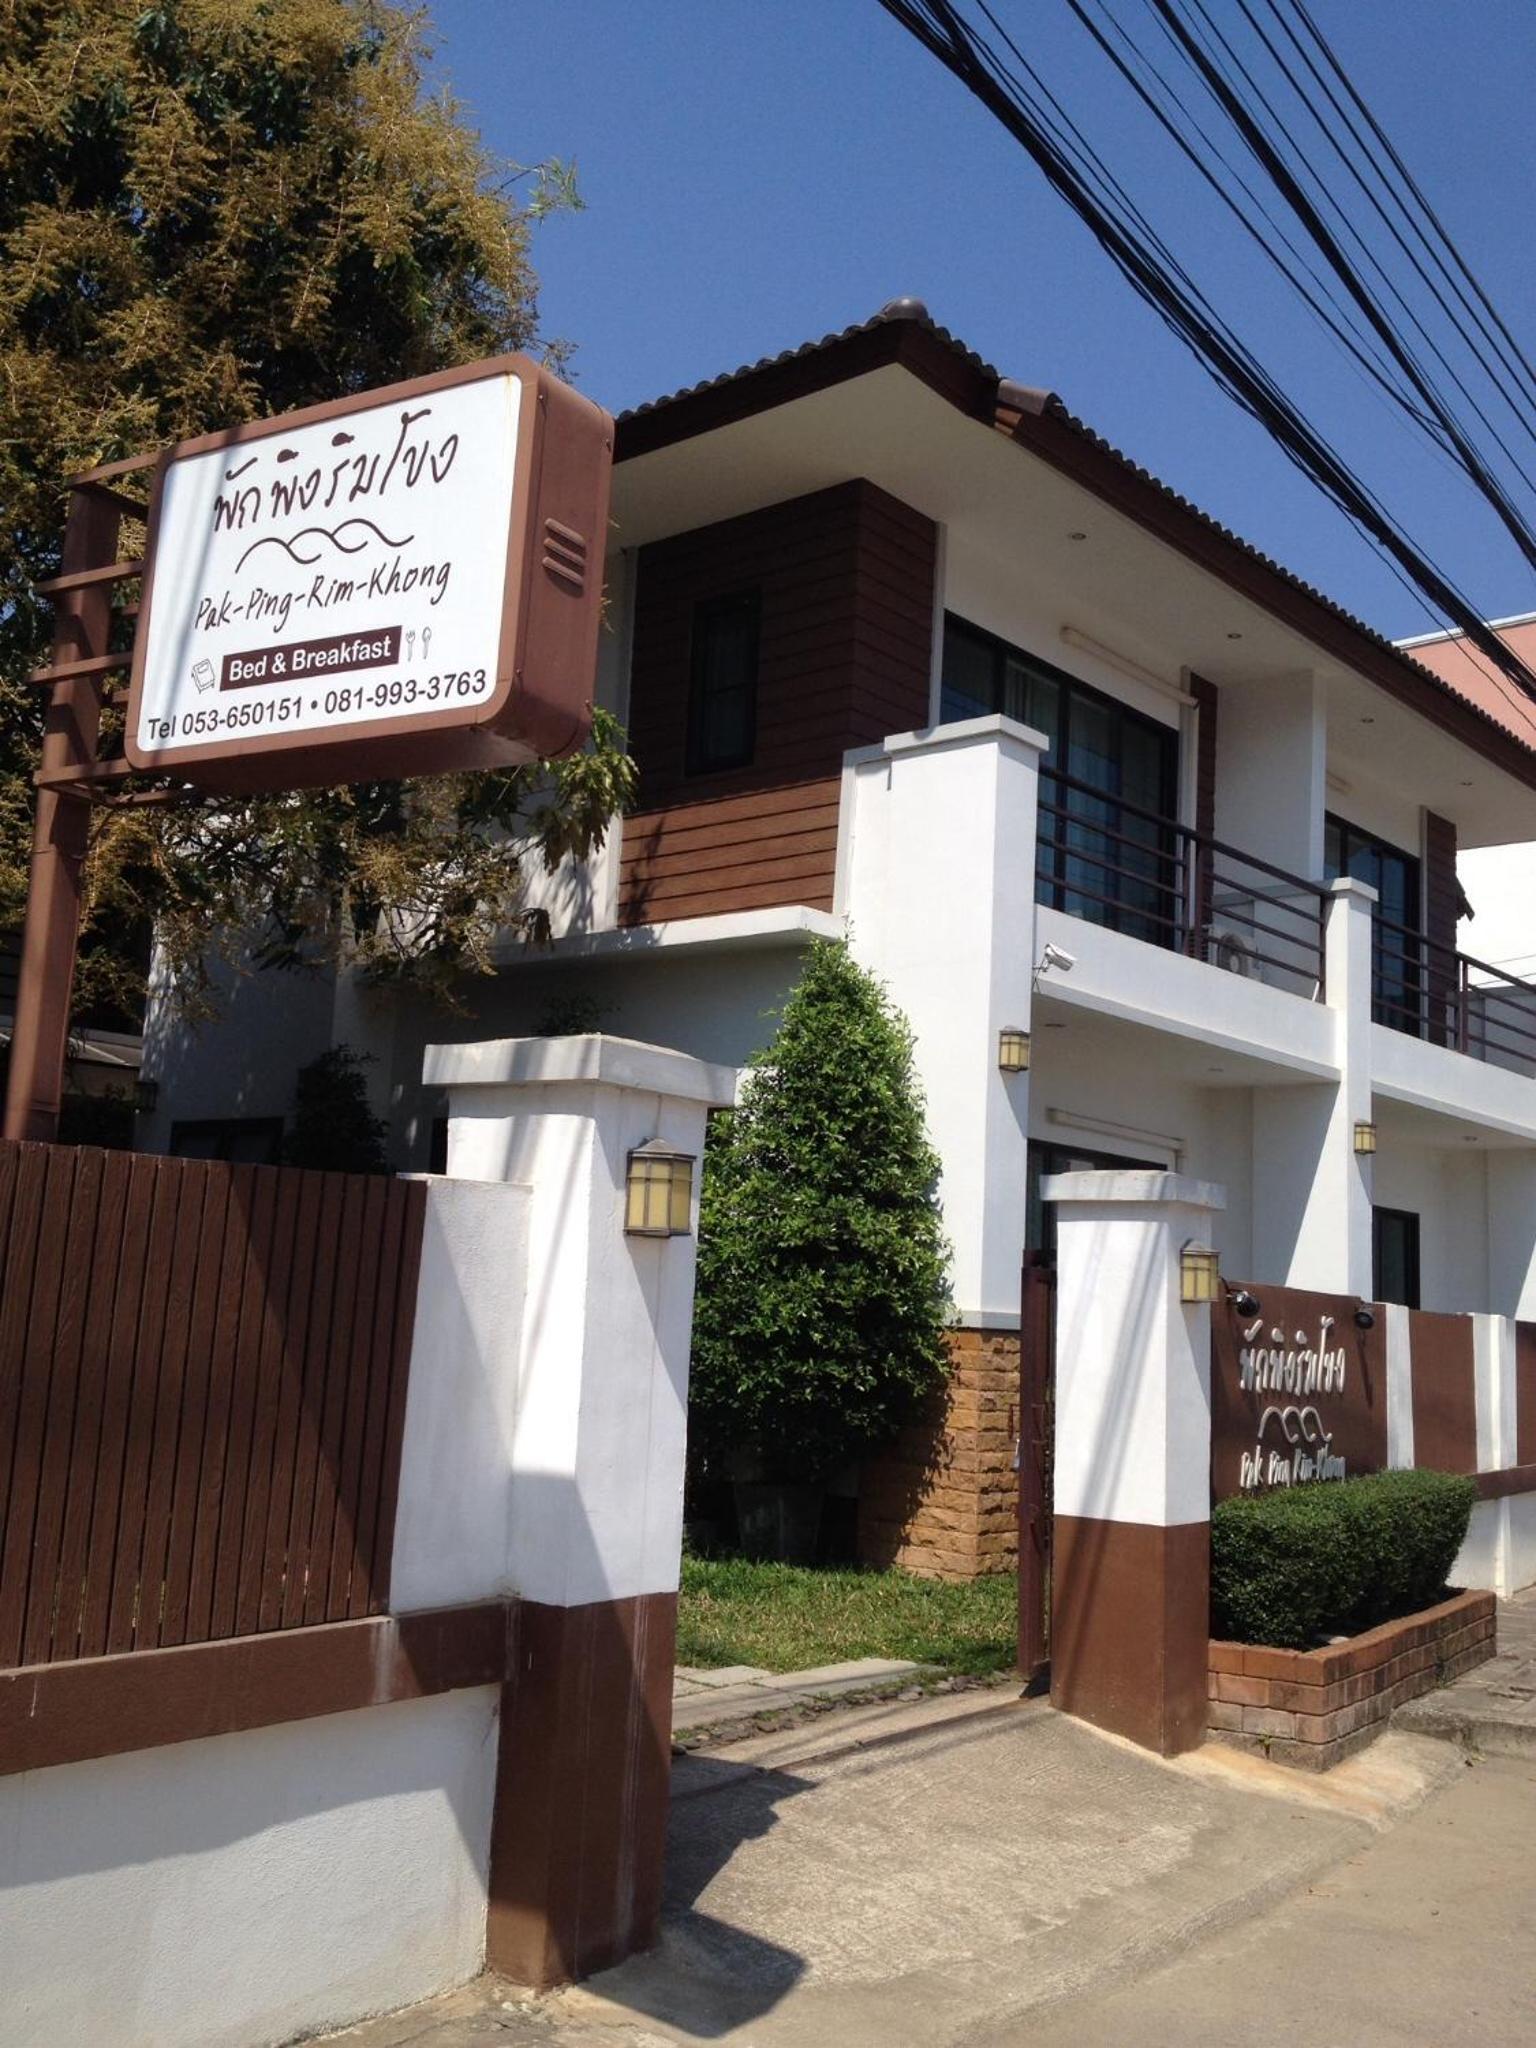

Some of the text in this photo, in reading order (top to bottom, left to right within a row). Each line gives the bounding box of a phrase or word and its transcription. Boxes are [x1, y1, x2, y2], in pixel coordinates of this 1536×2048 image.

[194, 555, 452, 633] Pak-Ping-Rim-Khong
[228, 634, 392, 682] Bed & Breakfast
[148, 668, 487, 741] Tel 053-650151 081-993-3763
